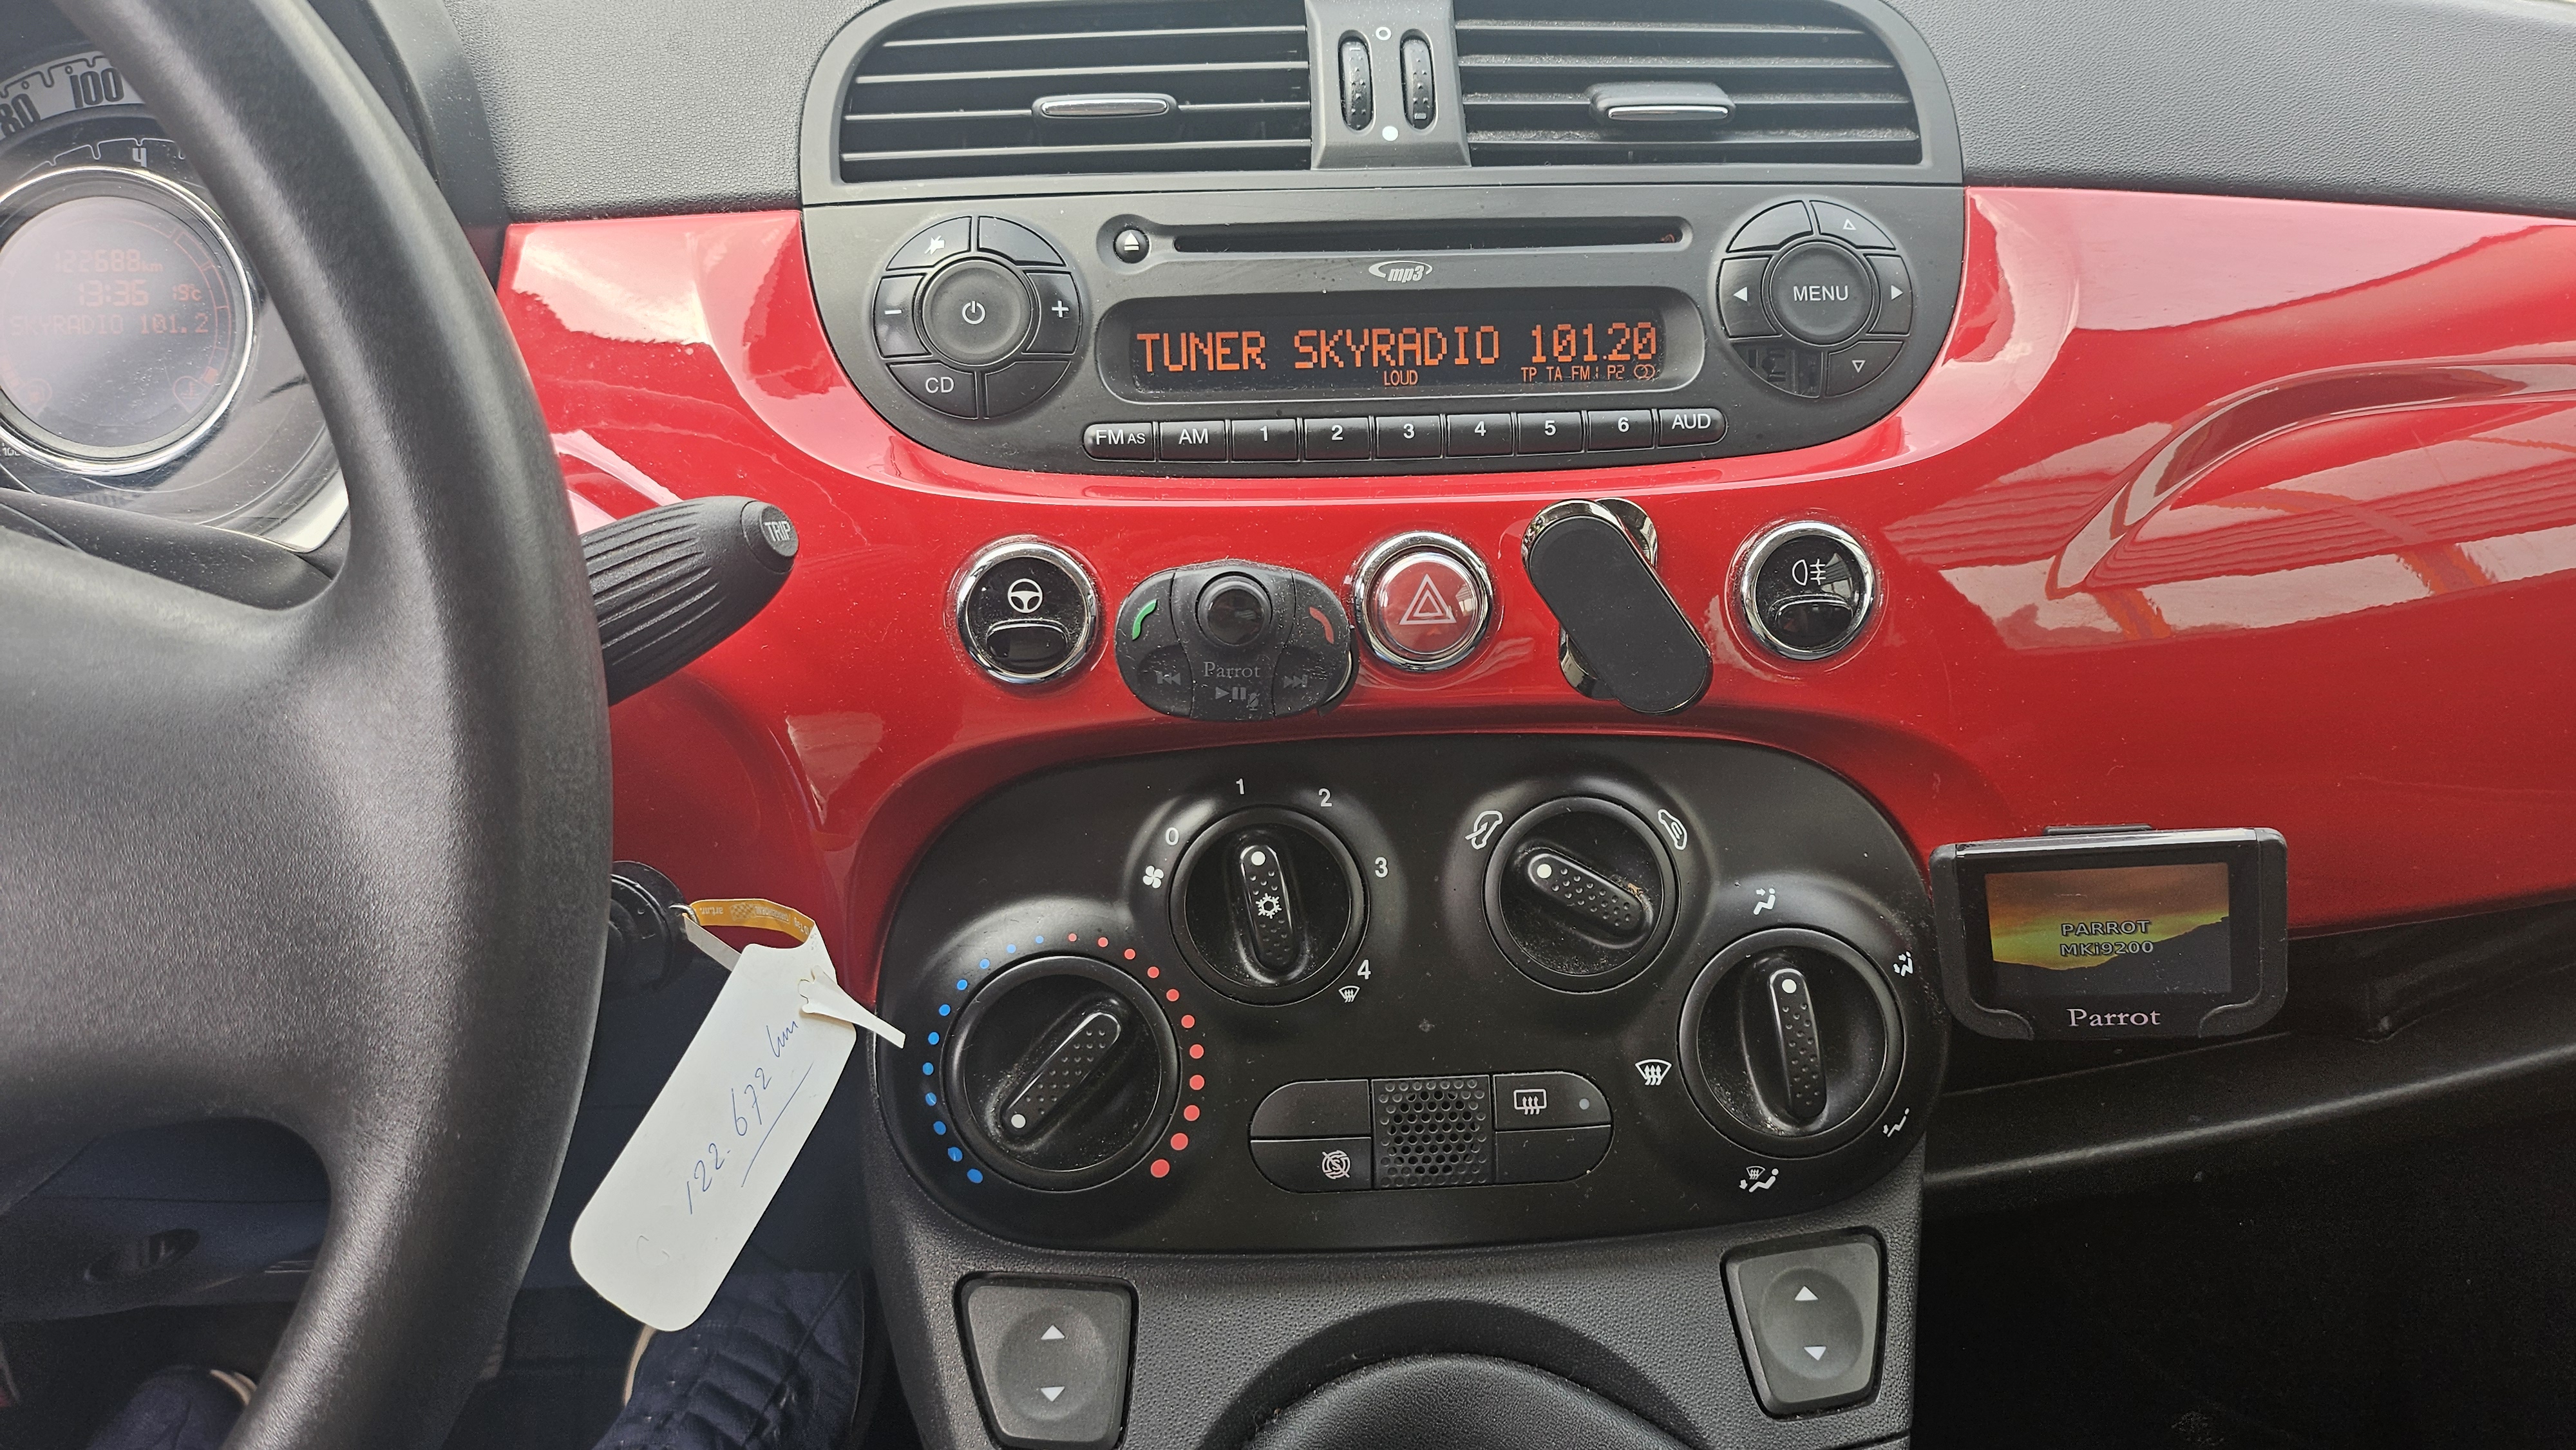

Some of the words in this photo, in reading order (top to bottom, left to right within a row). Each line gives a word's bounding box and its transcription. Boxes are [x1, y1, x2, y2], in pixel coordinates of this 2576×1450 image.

[69, 67, 125, 108] 100
[133, 147, 147, 167] 4
[1388, 265, 1425, 283] mp3
[1793, 285, 1849, 301] MENU
[1137, 331, 1266, 372] TUNER
[1294, 326, 1499, 369] SKYRADIO
[1531, 323, 1656, 362] 101.20
[1383, 370, 1418, 386] LOUD
[1520, 367, 1537, 382] TP
[1546, 366, 1563, 382] TA
[925, 377, 954, 393] CD
[1474, 420, 1486, 437] 4
[1545, 420, 1557, 435] 5
[1618, 417, 1629, 432] 6
[1671, 413, 1711, 429] AUD
[1095, 429, 1124, 445] FM
[1127, 433, 1146, 444] AS
[1179, 429, 1209, 444] AM
[1260, 426, 1269, 441] 1
[1331, 425, 1343, 440] 2
[1403, 423, 1415, 439] 3
[764, 520, 791, 541] TRIP
[1203, 661, 1261, 679] Parrot
[1236, 778, 1245, 795] 1
[1318, 788, 1332, 807] 2
[1165, 827, 1179, 846] 0
[1375, 856, 1388, 878] 3
[2061, 919, 2151, 936] PARROT
[2060, 941, 2154, 956] MKi9200
[1357, 959, 1371, 979] 4
[2066, 1008, 2161, 1028] Parrot
